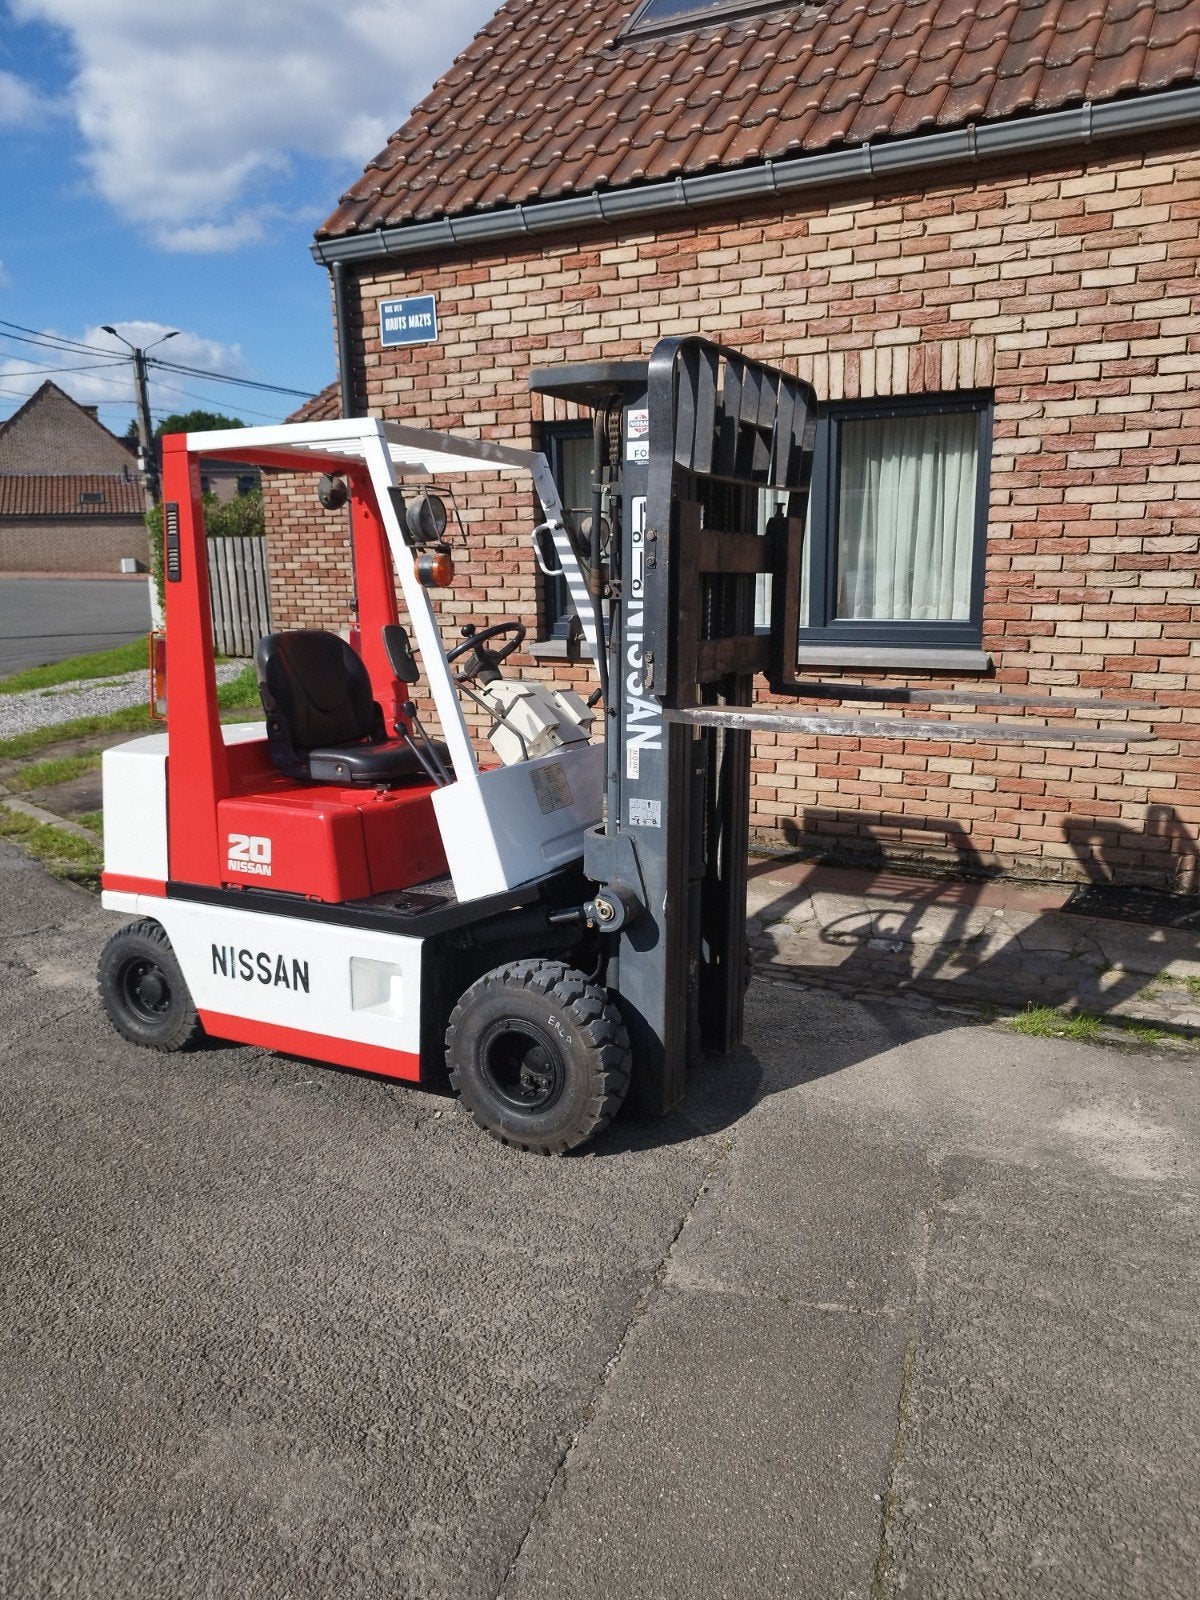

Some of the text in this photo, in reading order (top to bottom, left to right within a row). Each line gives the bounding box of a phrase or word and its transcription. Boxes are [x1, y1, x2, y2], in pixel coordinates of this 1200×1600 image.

[385, 316, 407, 331] HAUTS
[228, 833, 272, 864] 20
[228, 859, 272, 877] NISSAN
[211, 943, 310, 994] NISSAN
